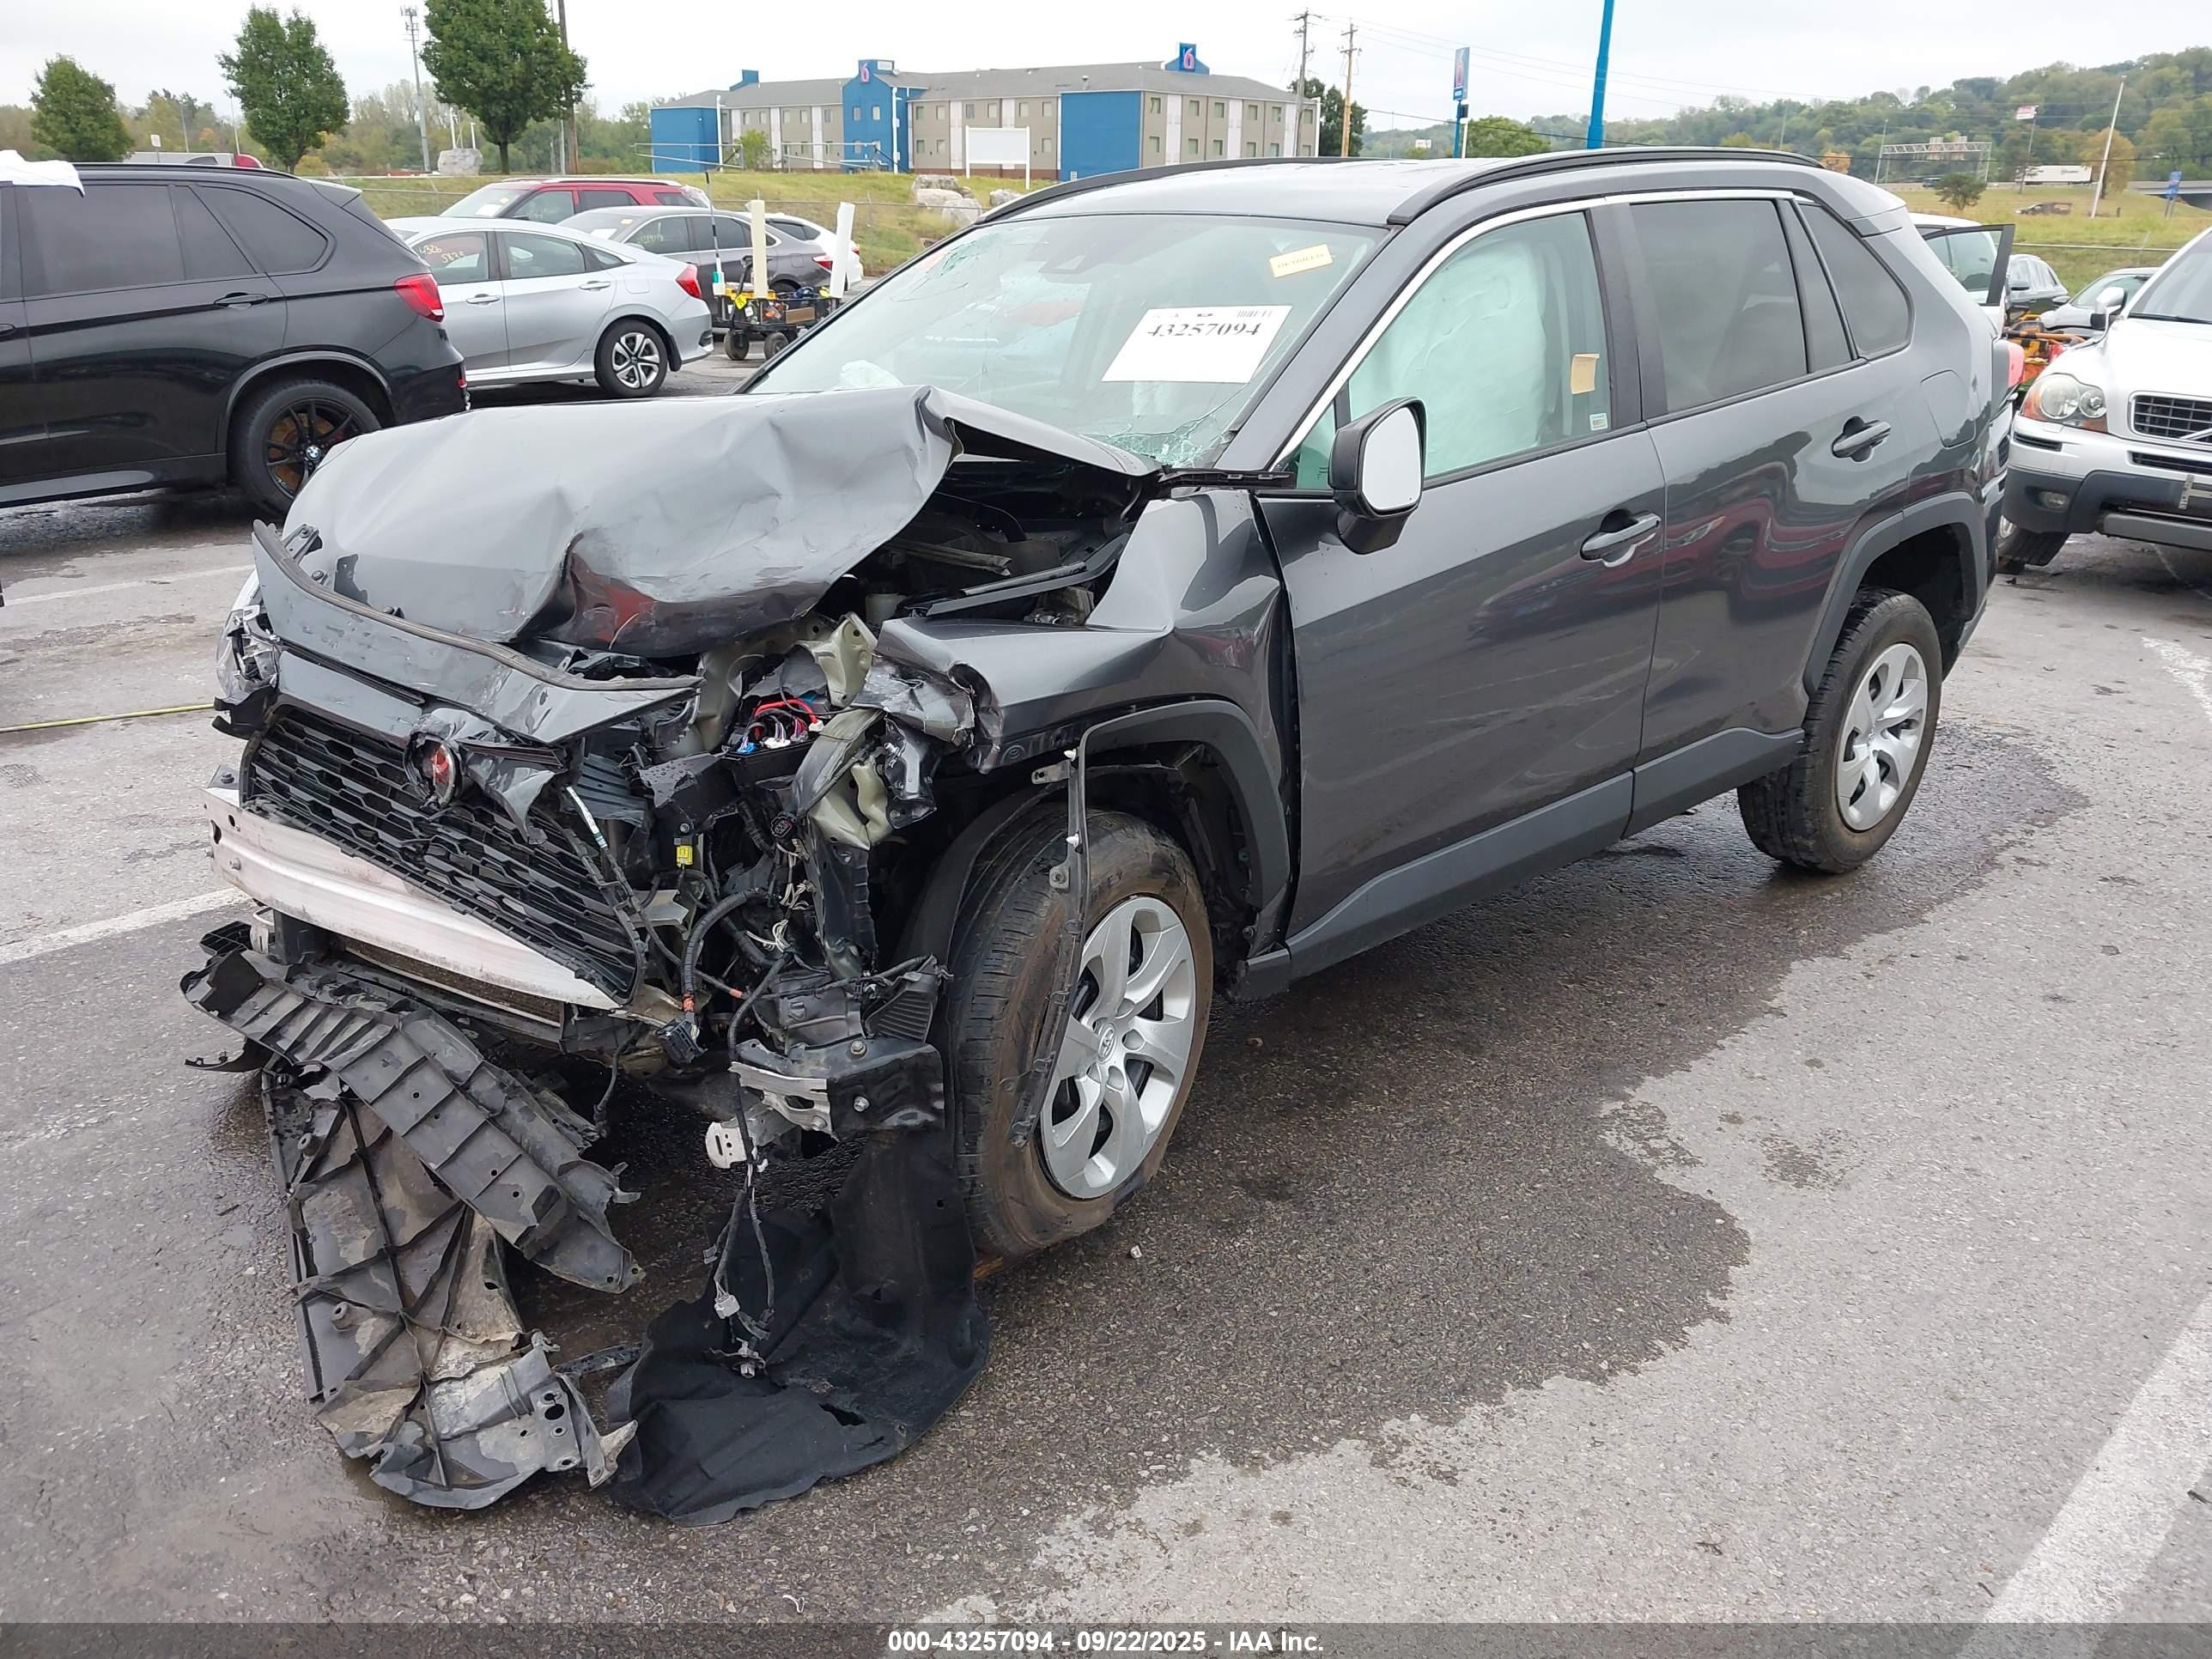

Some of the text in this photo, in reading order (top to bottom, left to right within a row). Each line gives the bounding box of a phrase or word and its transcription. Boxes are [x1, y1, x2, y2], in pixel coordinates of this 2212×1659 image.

[1183, 47, 1194, 70] 6
[860, 62, 870, 82] 6
[1147, 322, 1261, 337] 43257094
